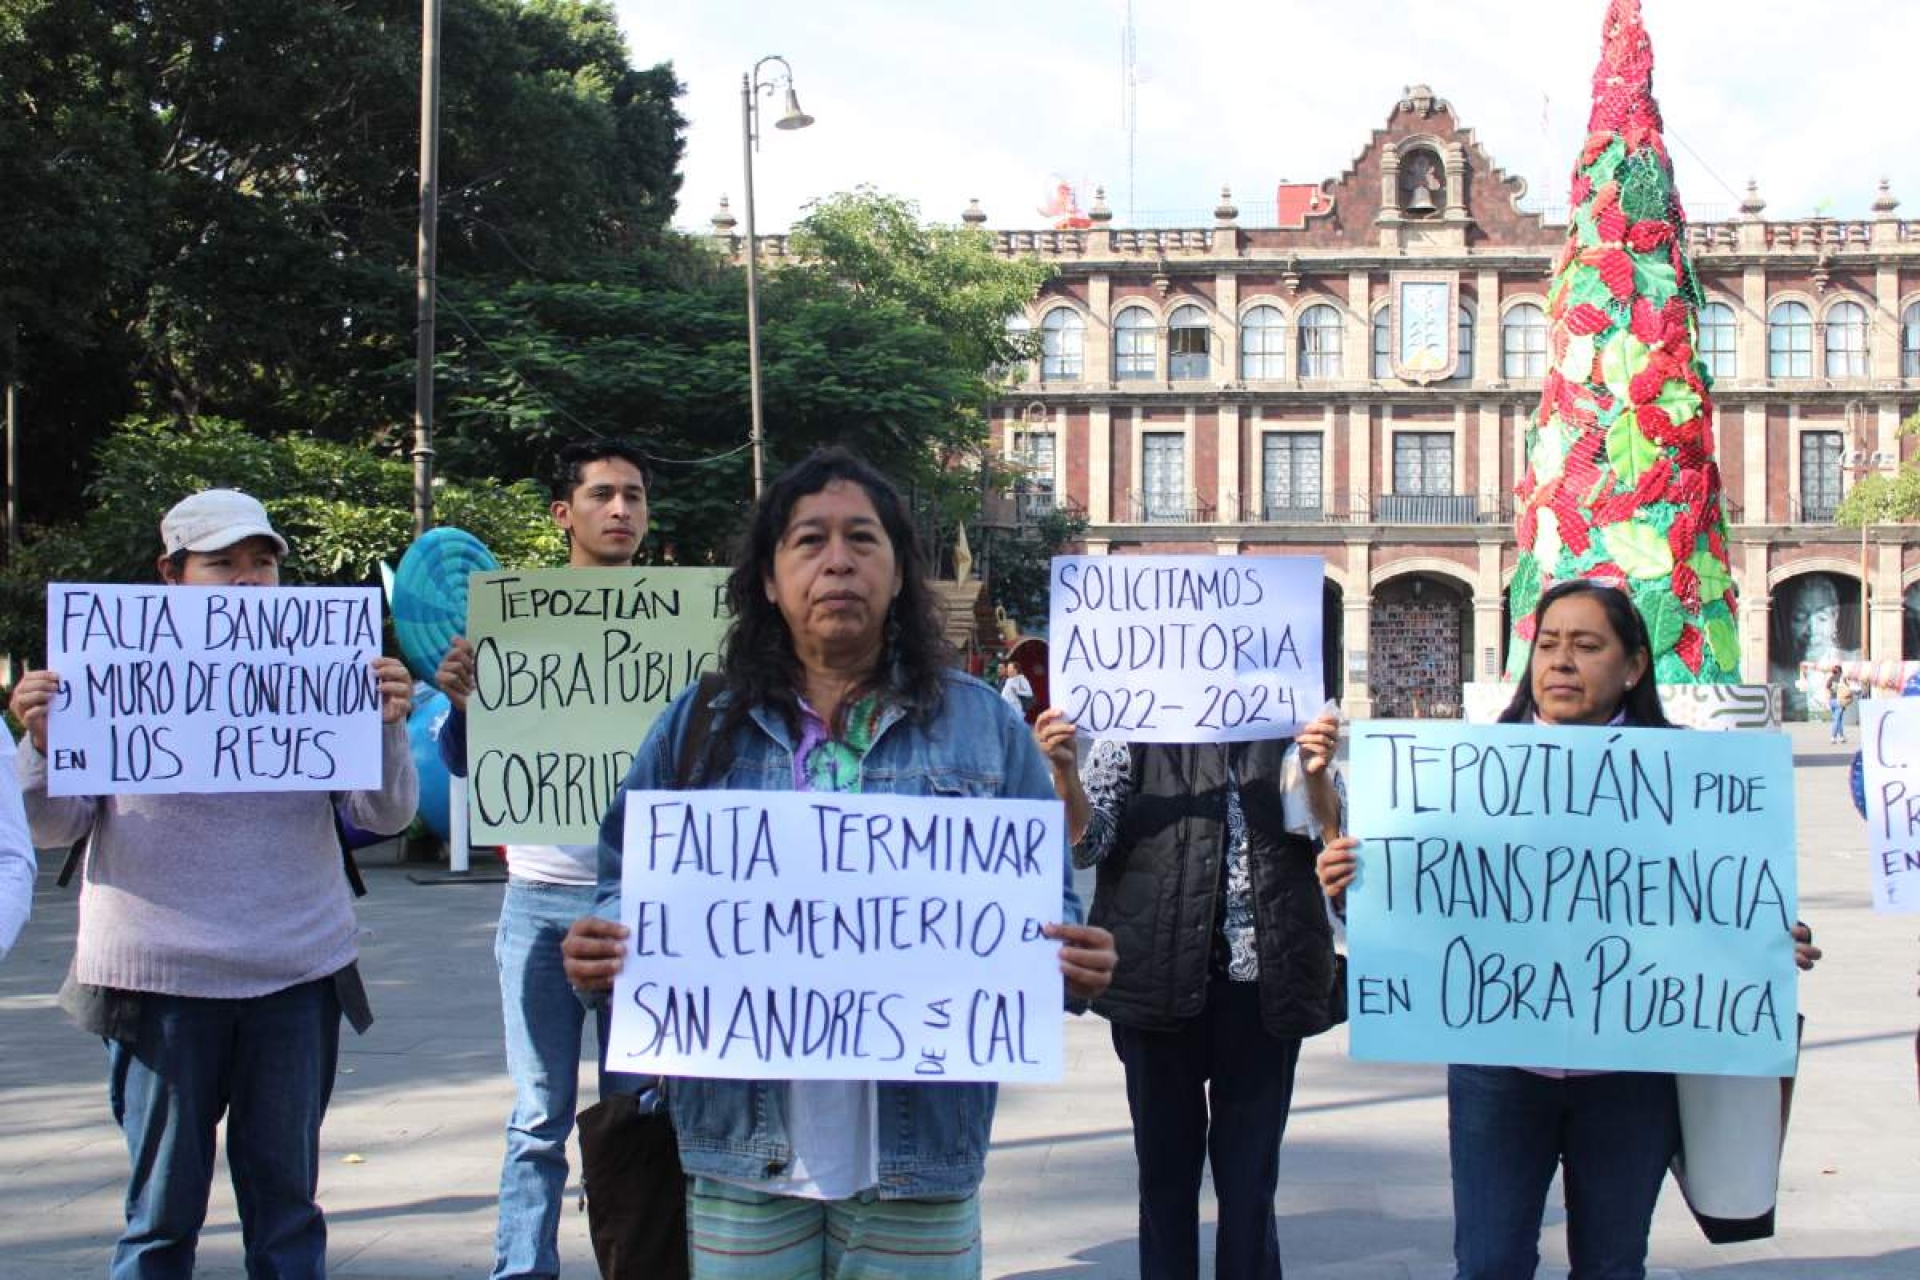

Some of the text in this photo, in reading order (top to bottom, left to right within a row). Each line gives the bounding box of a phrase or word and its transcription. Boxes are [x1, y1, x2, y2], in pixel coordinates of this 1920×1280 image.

[486, 577, 680, 622] TEPOZTLÁN
[1060, 564, 1264, 614] SOLICITAMOS
[62, 591, 375, 655] FALTA BANQUETA
[1062, 623, 1303, 673] AUDITORIA
[86, 660, 174, 718] MURO
[186, 660, 220, 715] DE
[228, 650, 379, 717] CONTENCIÓN
[474, 636, 595, 711] OBRA
[1069, 684, 1157, 733] 2022
[1195, 684, 1296, 730] 2024
[54, 725, 336, 782] EN LOS REYES
[1365, 733, 1767, 826] TEPOZTLÁN PIDE
[648, 802, 1046, 882] FALTA TERMINAR
[1365, 837, 1792, 931] TRANSPARENCIA
[636, 902, 682, 957] EL
[706, 897, 1006, 959] CEMENTERIO
[1358, 935, 1783, 1041] EN OBRA PÚBLICA
[627, 982, 1040, 1075] SAN ANDRES DE LA CAL
